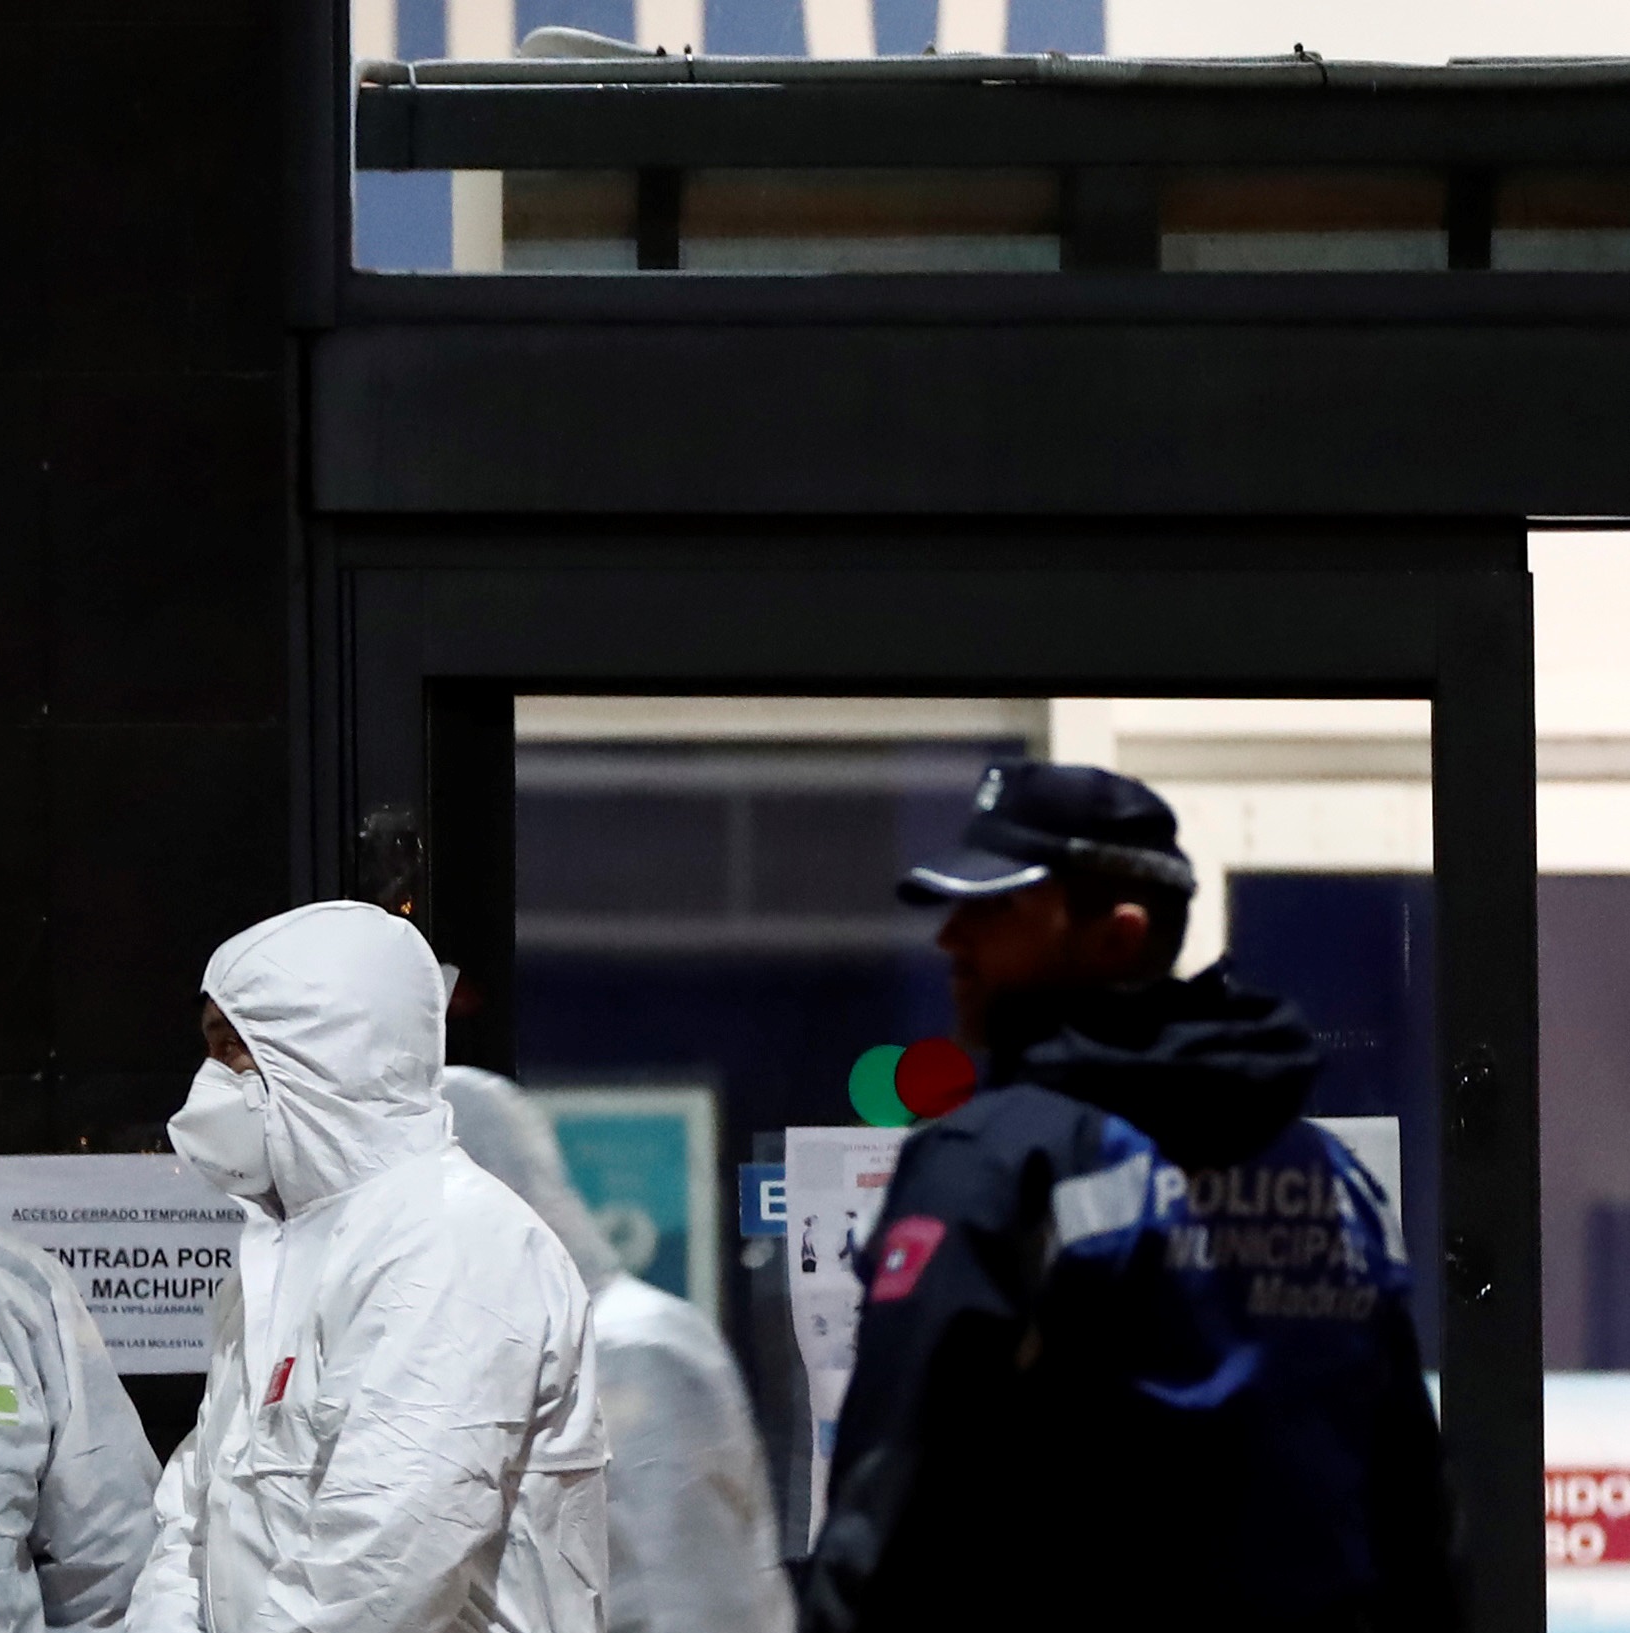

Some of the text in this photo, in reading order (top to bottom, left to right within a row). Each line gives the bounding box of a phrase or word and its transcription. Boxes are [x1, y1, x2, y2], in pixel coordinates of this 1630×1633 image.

[12, 1207, 245, 1221] ACCESO CERRADO TEMPORALMEN
[43, 1247, 232, 1269] NTRADA POR
